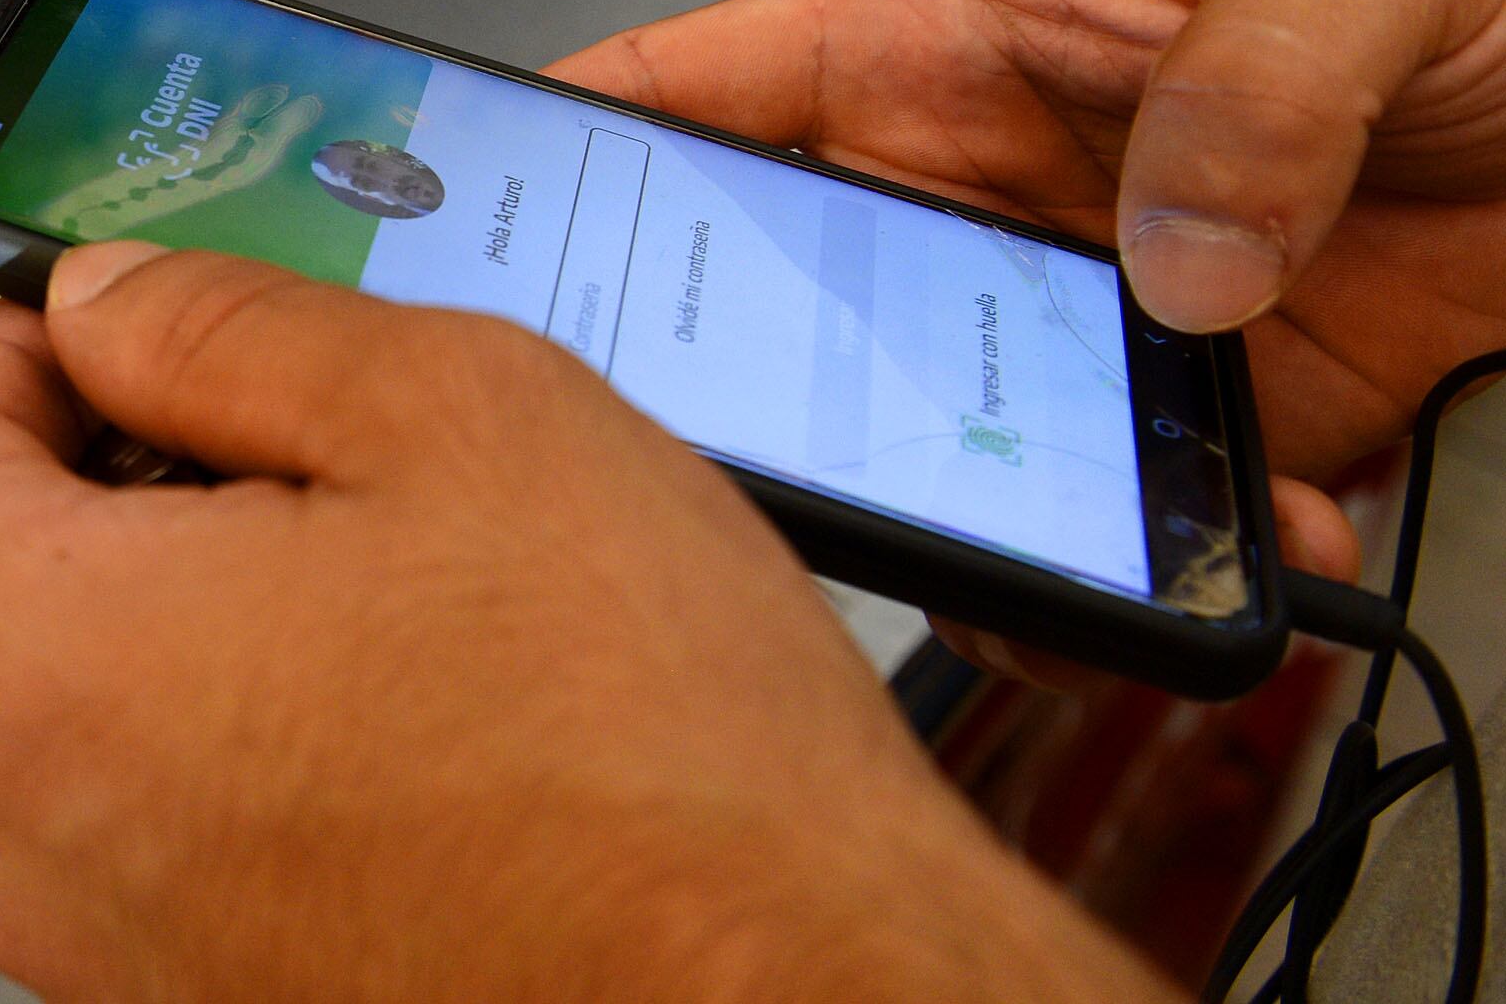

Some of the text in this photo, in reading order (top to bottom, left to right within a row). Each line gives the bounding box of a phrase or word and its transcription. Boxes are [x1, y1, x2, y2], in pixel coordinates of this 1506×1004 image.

[140, 52, 203, 128] Cuenta
[176, 97, 222, 141] DNI
[483, 175, 525, 266] ¡Hola Arturo!
[674, 220, 711, 343] Olvidé mi contraseña
[975, 293, 1006, 417] Ingresar con huella
